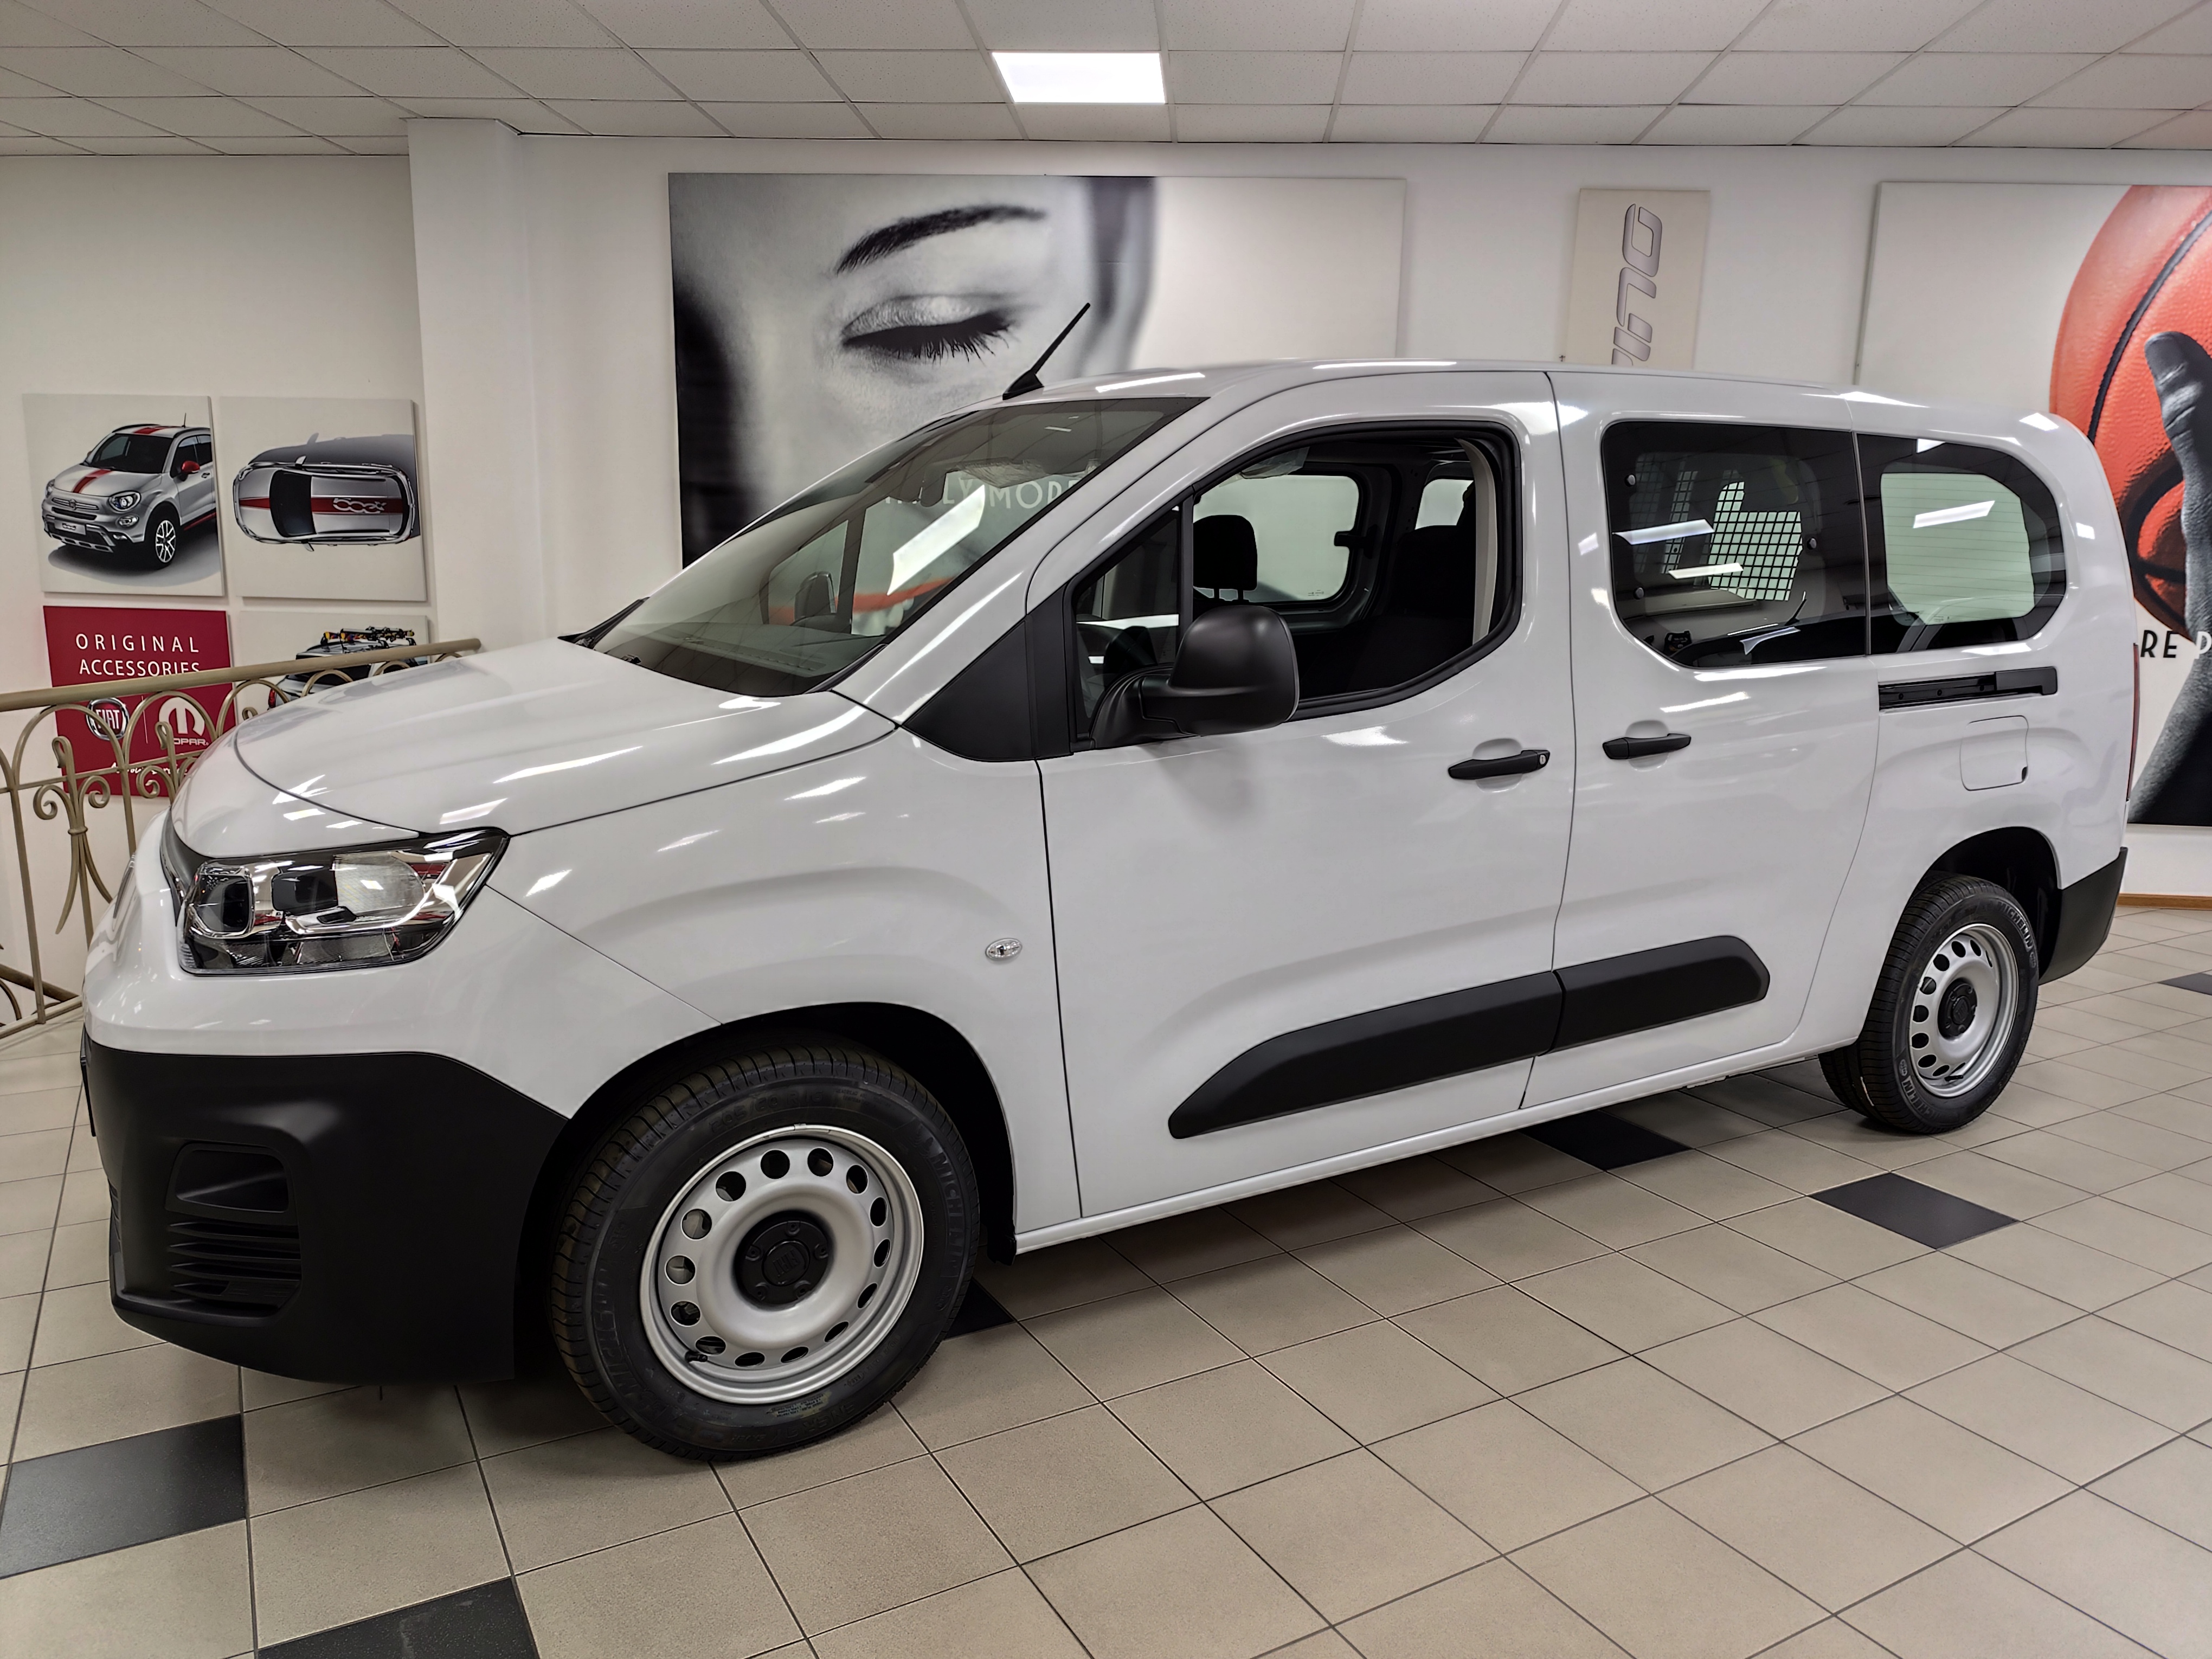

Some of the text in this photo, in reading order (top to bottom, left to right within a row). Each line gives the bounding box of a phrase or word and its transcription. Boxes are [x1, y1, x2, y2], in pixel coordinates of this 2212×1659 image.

[76, 633, 199, 652] ORIGINAL
[79, 659, 200, 677] ACCESSORIES
[95, 709, 120, 729] FIAT
